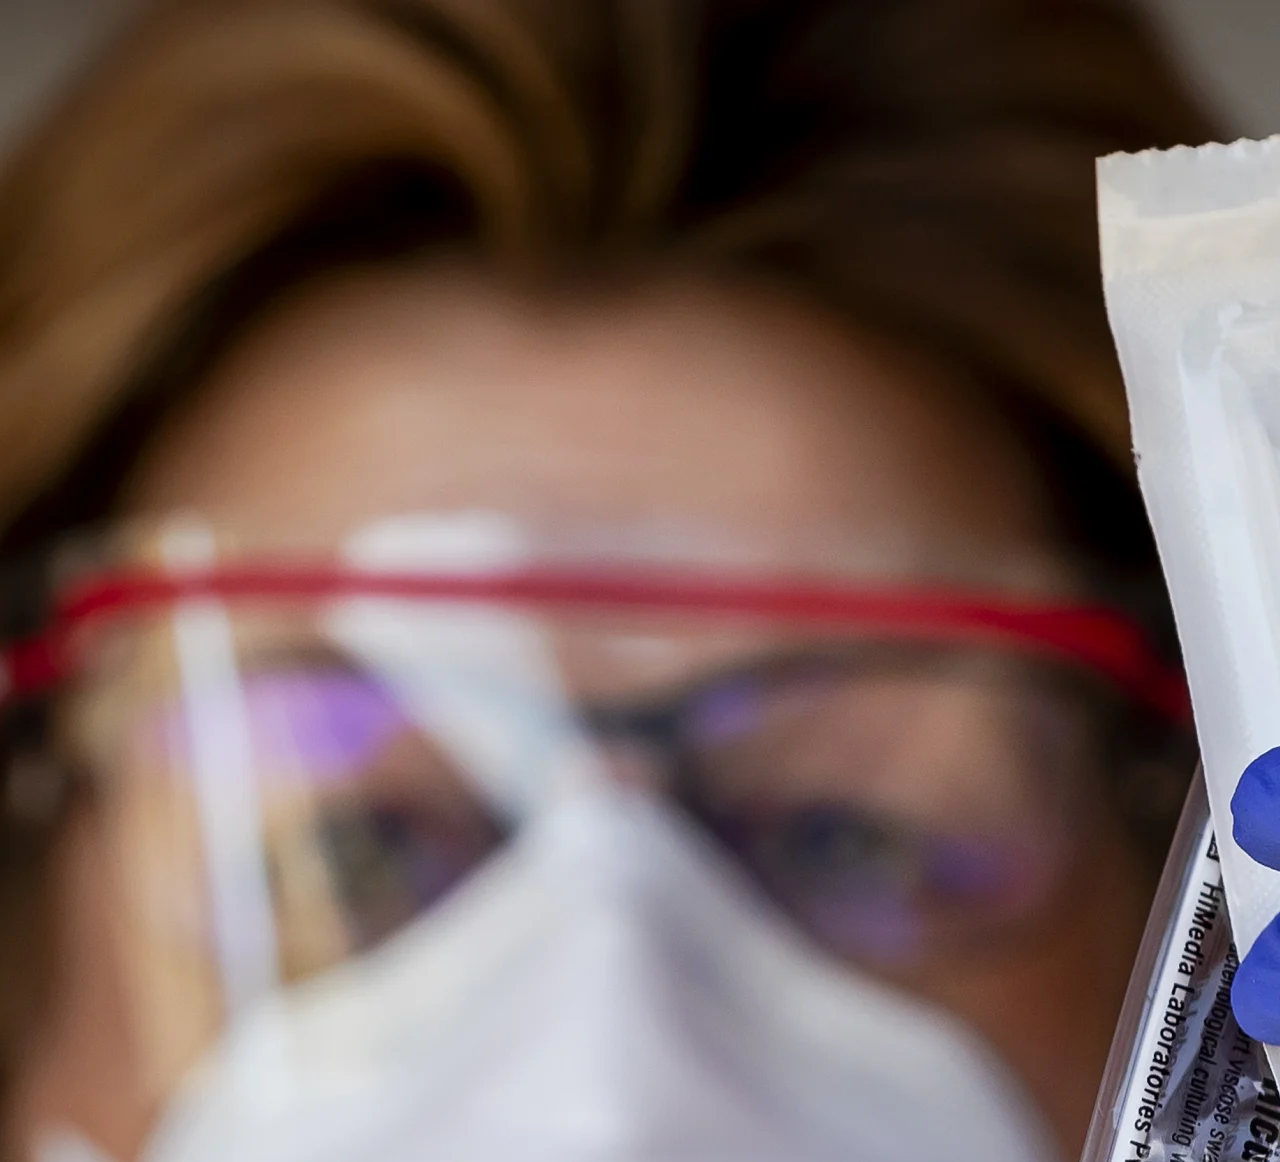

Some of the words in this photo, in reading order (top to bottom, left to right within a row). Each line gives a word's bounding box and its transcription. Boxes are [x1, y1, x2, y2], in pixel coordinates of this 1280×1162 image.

[1177, 882, 1226, 979] HiMedia
[1134, 982, 1197, 1136] Laboratories
[1214, 1060, 1245, 1125] viscose
[1171, 1066, 1209, 1148] culturing
